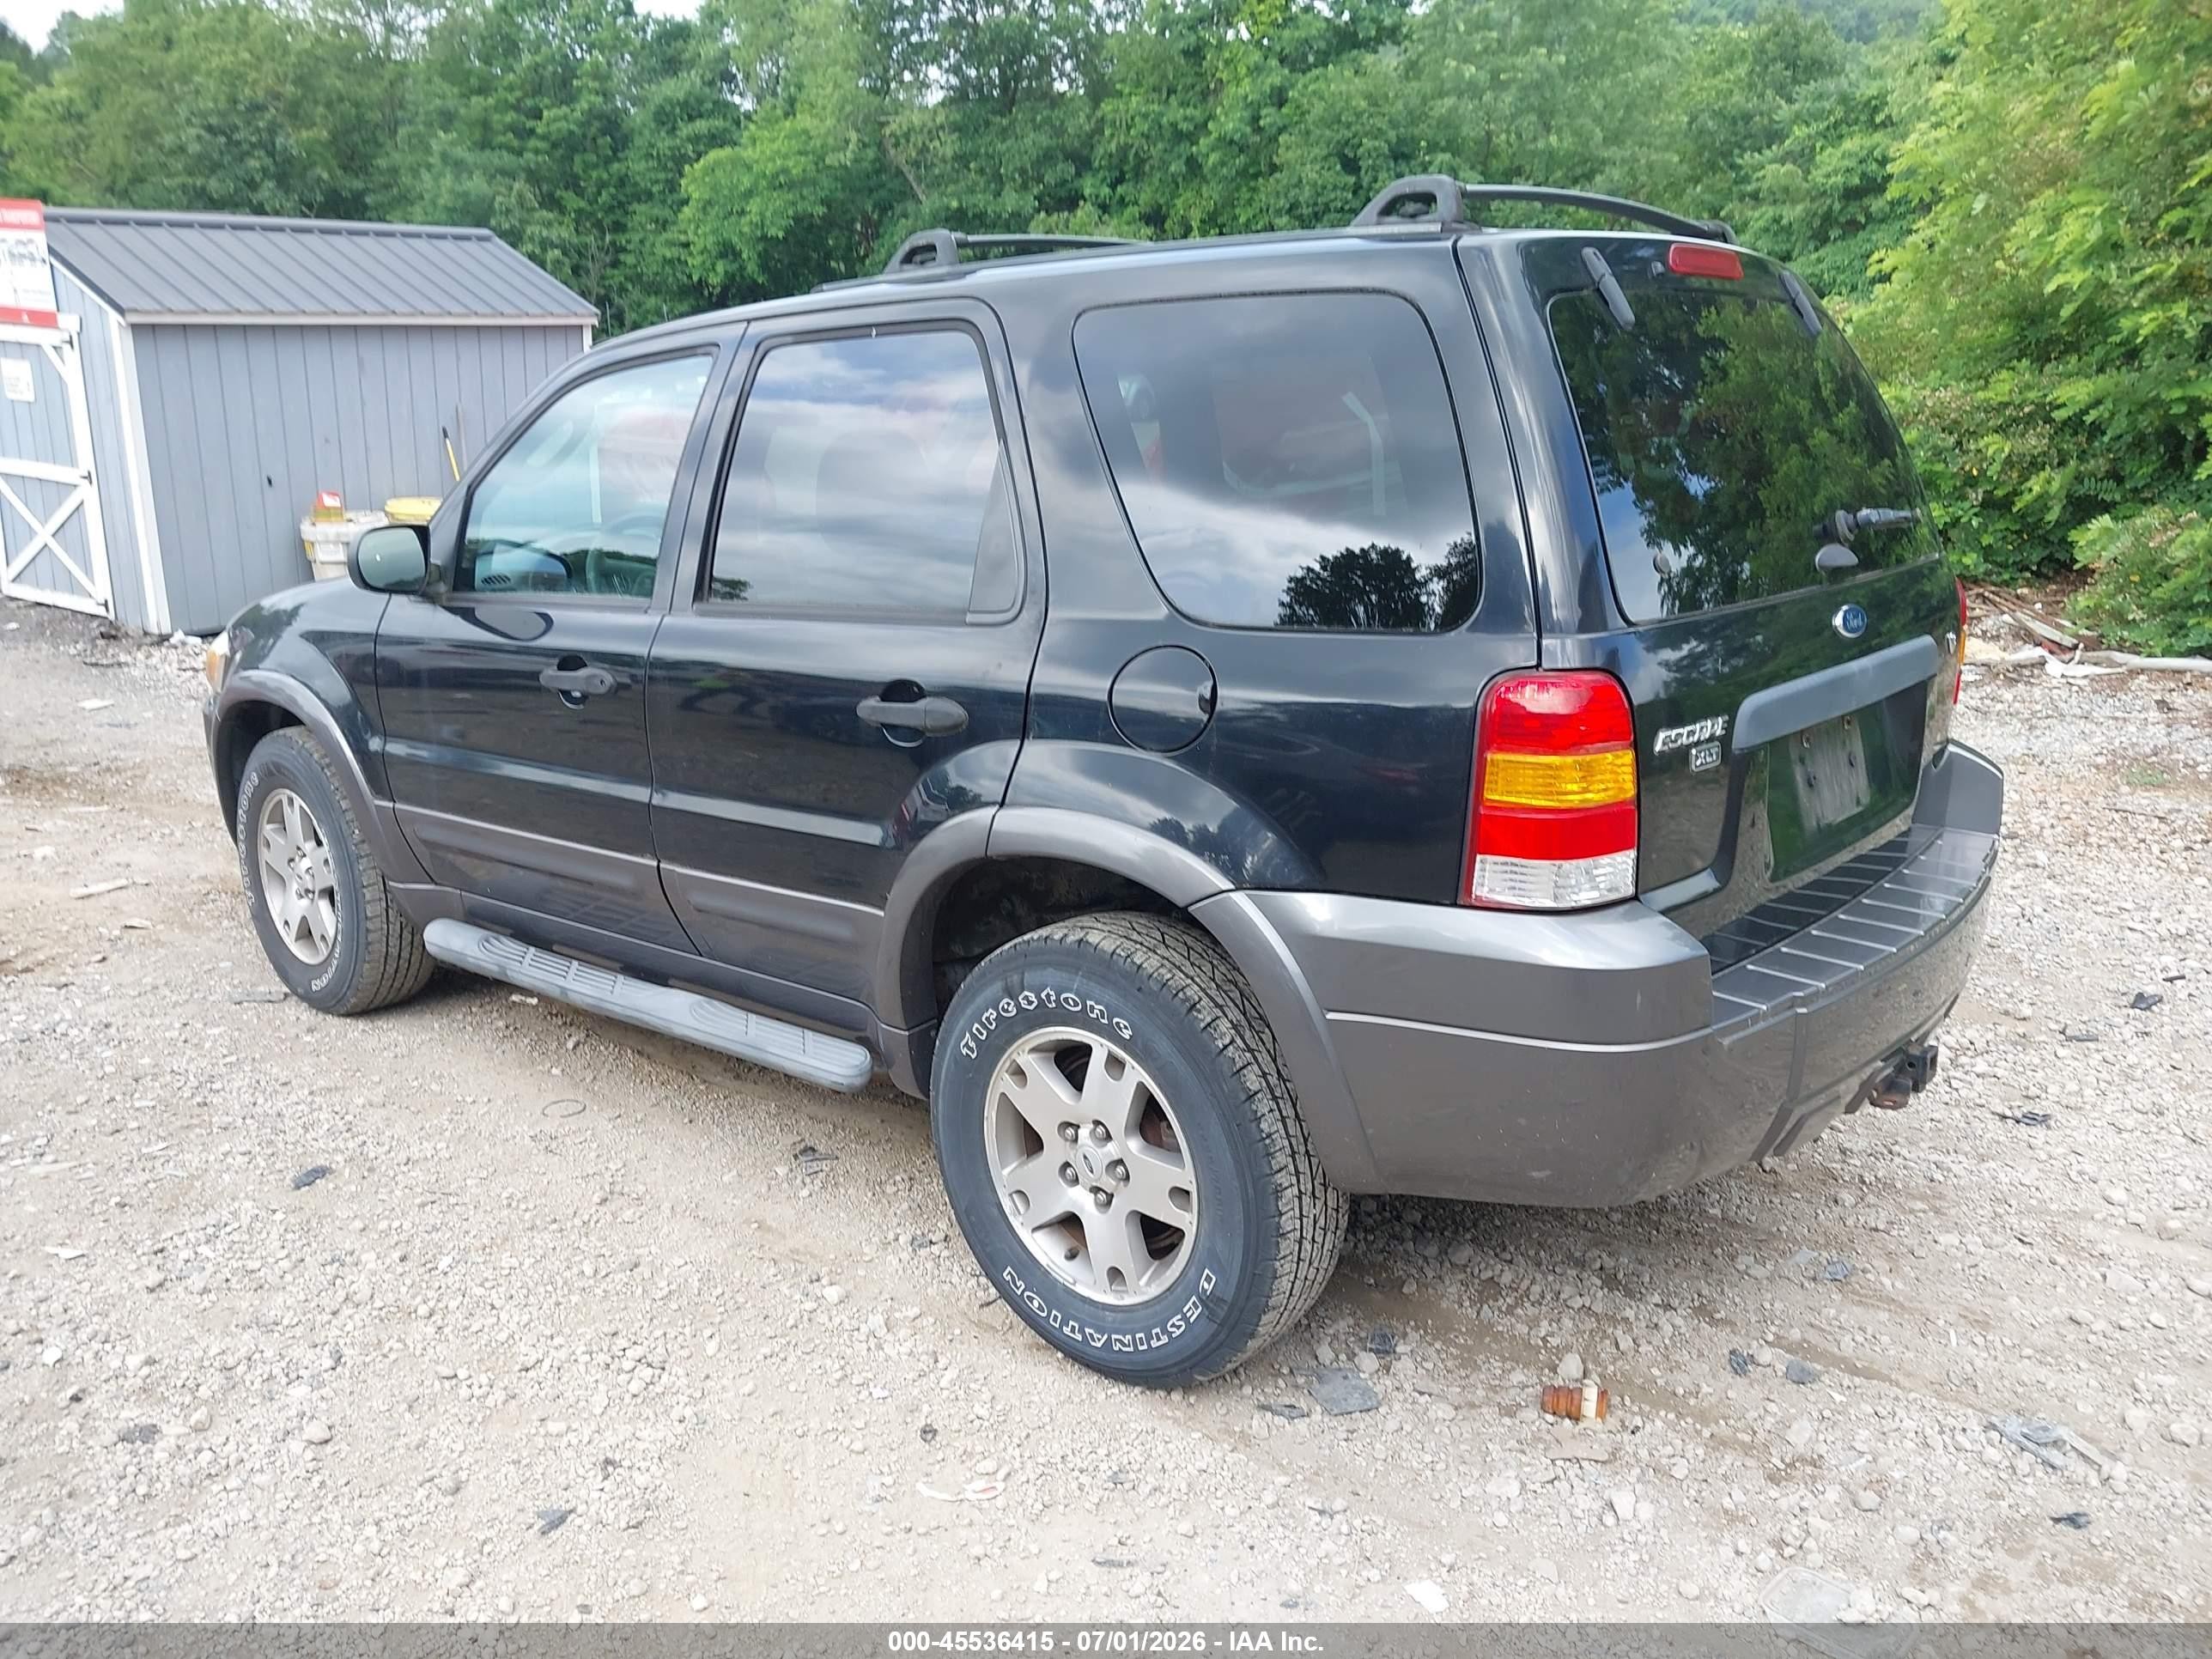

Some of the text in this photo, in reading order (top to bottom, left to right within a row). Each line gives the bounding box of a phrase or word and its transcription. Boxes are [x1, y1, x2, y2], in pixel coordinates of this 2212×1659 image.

[1654, 714, 1729, 756] ESCAPE
[1695, 747, 1719, 767] XLT
[959, 986, 1133, 1060] Firestone
[1002, 1266, 1217, 1352] DESTINATION
